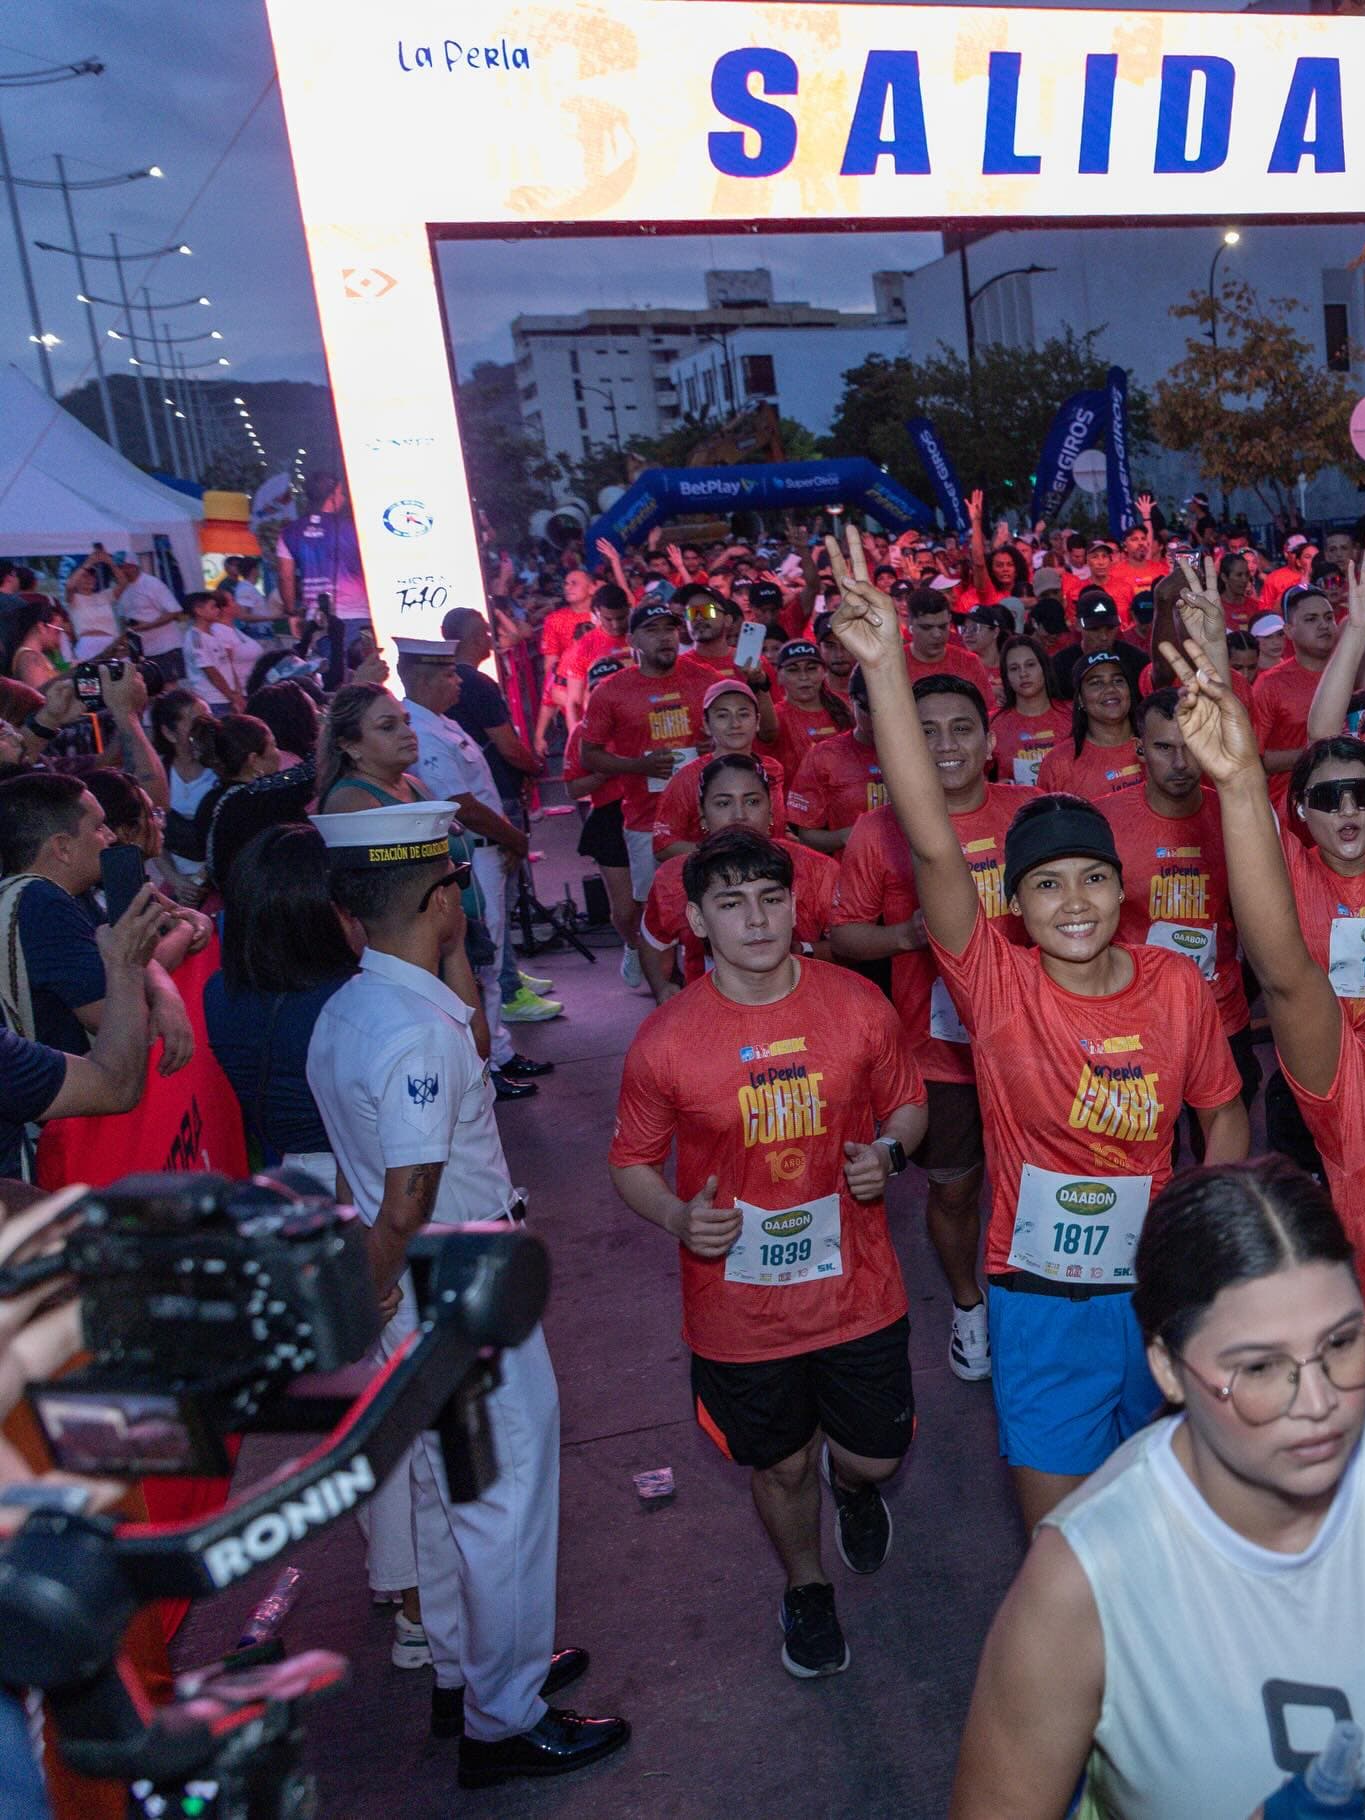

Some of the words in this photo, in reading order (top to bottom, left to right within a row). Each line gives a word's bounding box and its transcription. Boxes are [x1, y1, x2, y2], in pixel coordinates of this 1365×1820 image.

[398, 40, 433, 72] La
[444, 38, 530, 73] Perla
[708, 47, 1346, 178] SALIDA
[680, 479, 740, 496] BetPlay
[369, 844, 408, 862] ESTACIÓN
[410, 846, 420, 859] DE
[1173, 932, 1207, 945] DAABON
[750, 1071, 767, 1088] La
[768, 1062, 807, 1085] Perla
[738, 1072, 828, 1149] CORRE
[1069, 1063, 1165, 1142] CORRE
[1060, 1189, 1115, 1206] DAABON
[765, 1215, 811, 1232] DAABON
[759, 1238, 812, 1267] 1839
[1053, 1222, 1110, 1256] 1817
[203, 1454, 377, 1588] RONIN
